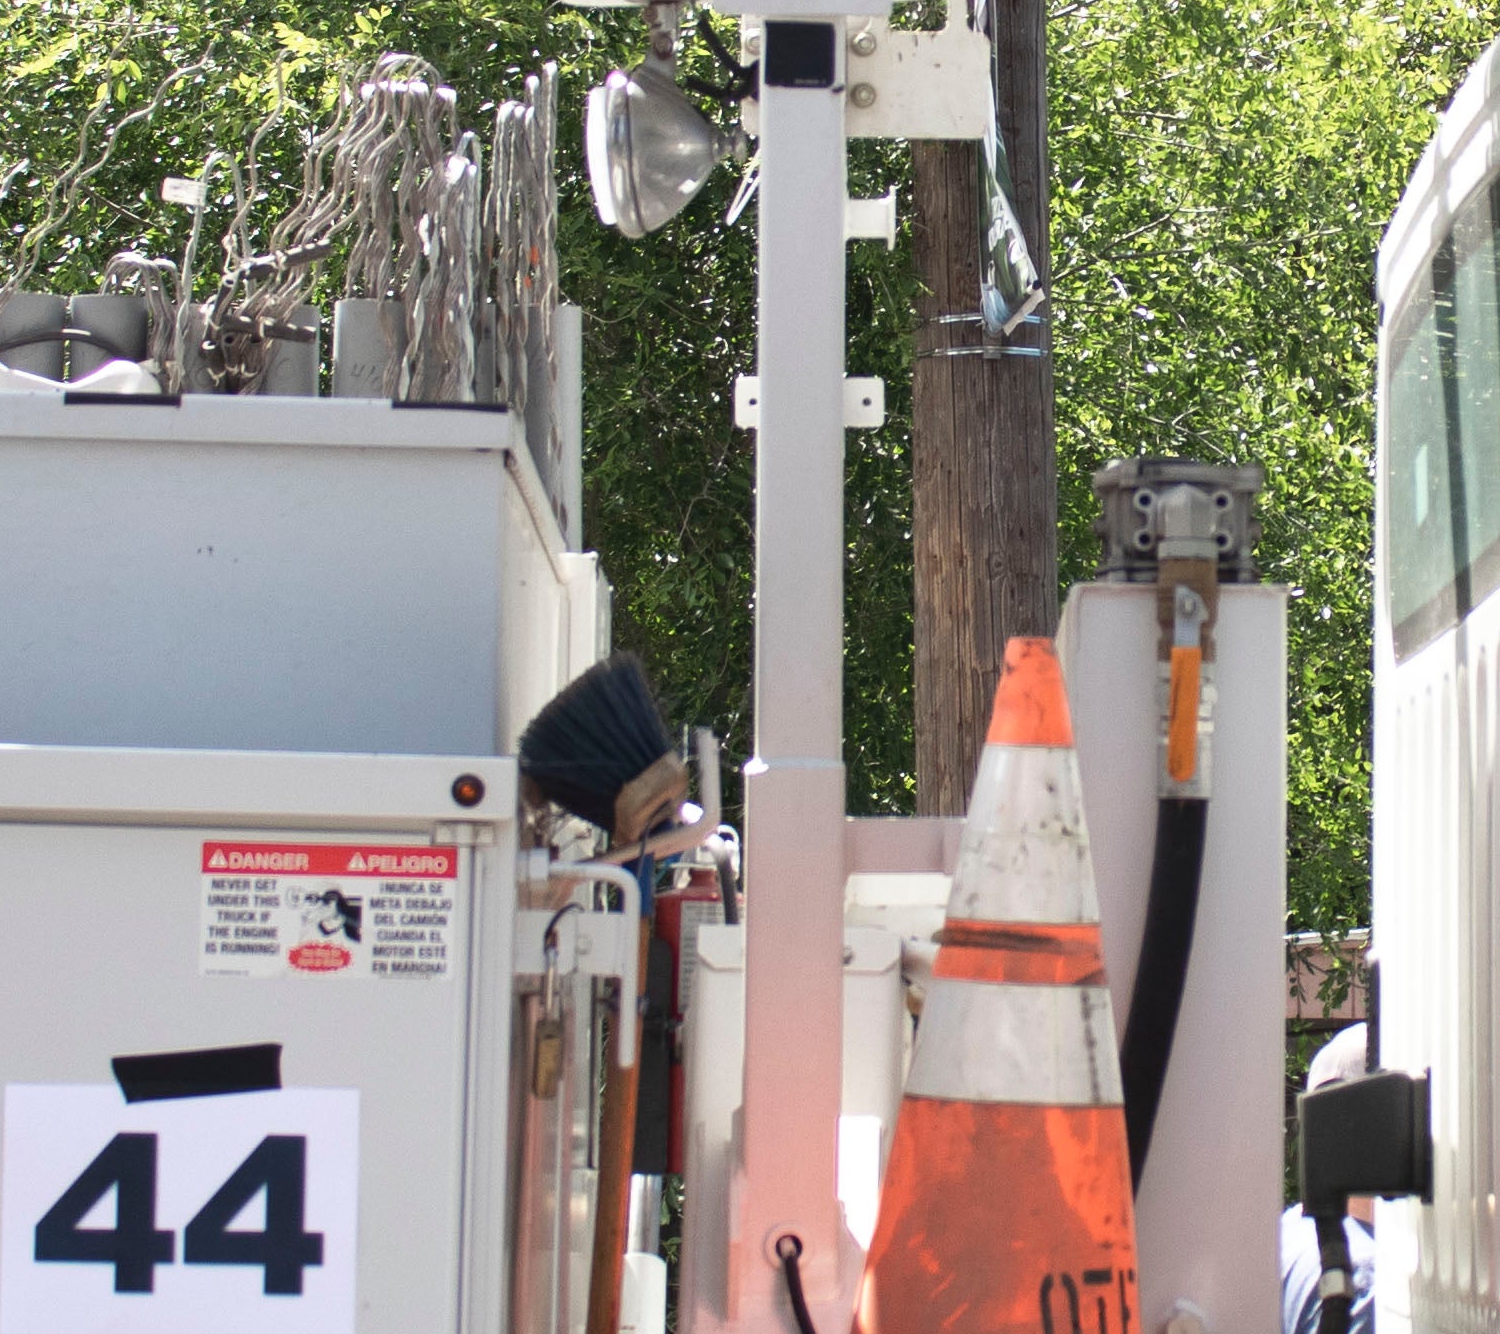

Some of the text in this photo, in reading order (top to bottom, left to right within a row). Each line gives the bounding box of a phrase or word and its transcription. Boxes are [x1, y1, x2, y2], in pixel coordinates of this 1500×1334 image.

[226, 852, 309, 872] DANGER
[366, 854, 449, 875] PELIGRO
[211, 879, 277, 891] NEVER GET
[208, 894, 280, 907] UNDER THIS
[369, 898, 452, 911] META DEBAJO
[218, 910, 271, 922] TRUCK IF
[374, 914, 394, 925] DEL
[209, 926, 277, 938] THE ENGINE
[429, 930, 442, 942] EL
[205, 942, 217, 954] IS
[372, 946, 415, 957] MOTOR
[372, 961, 388, 972] EN
[34, 1132, 324, 1295] 44
